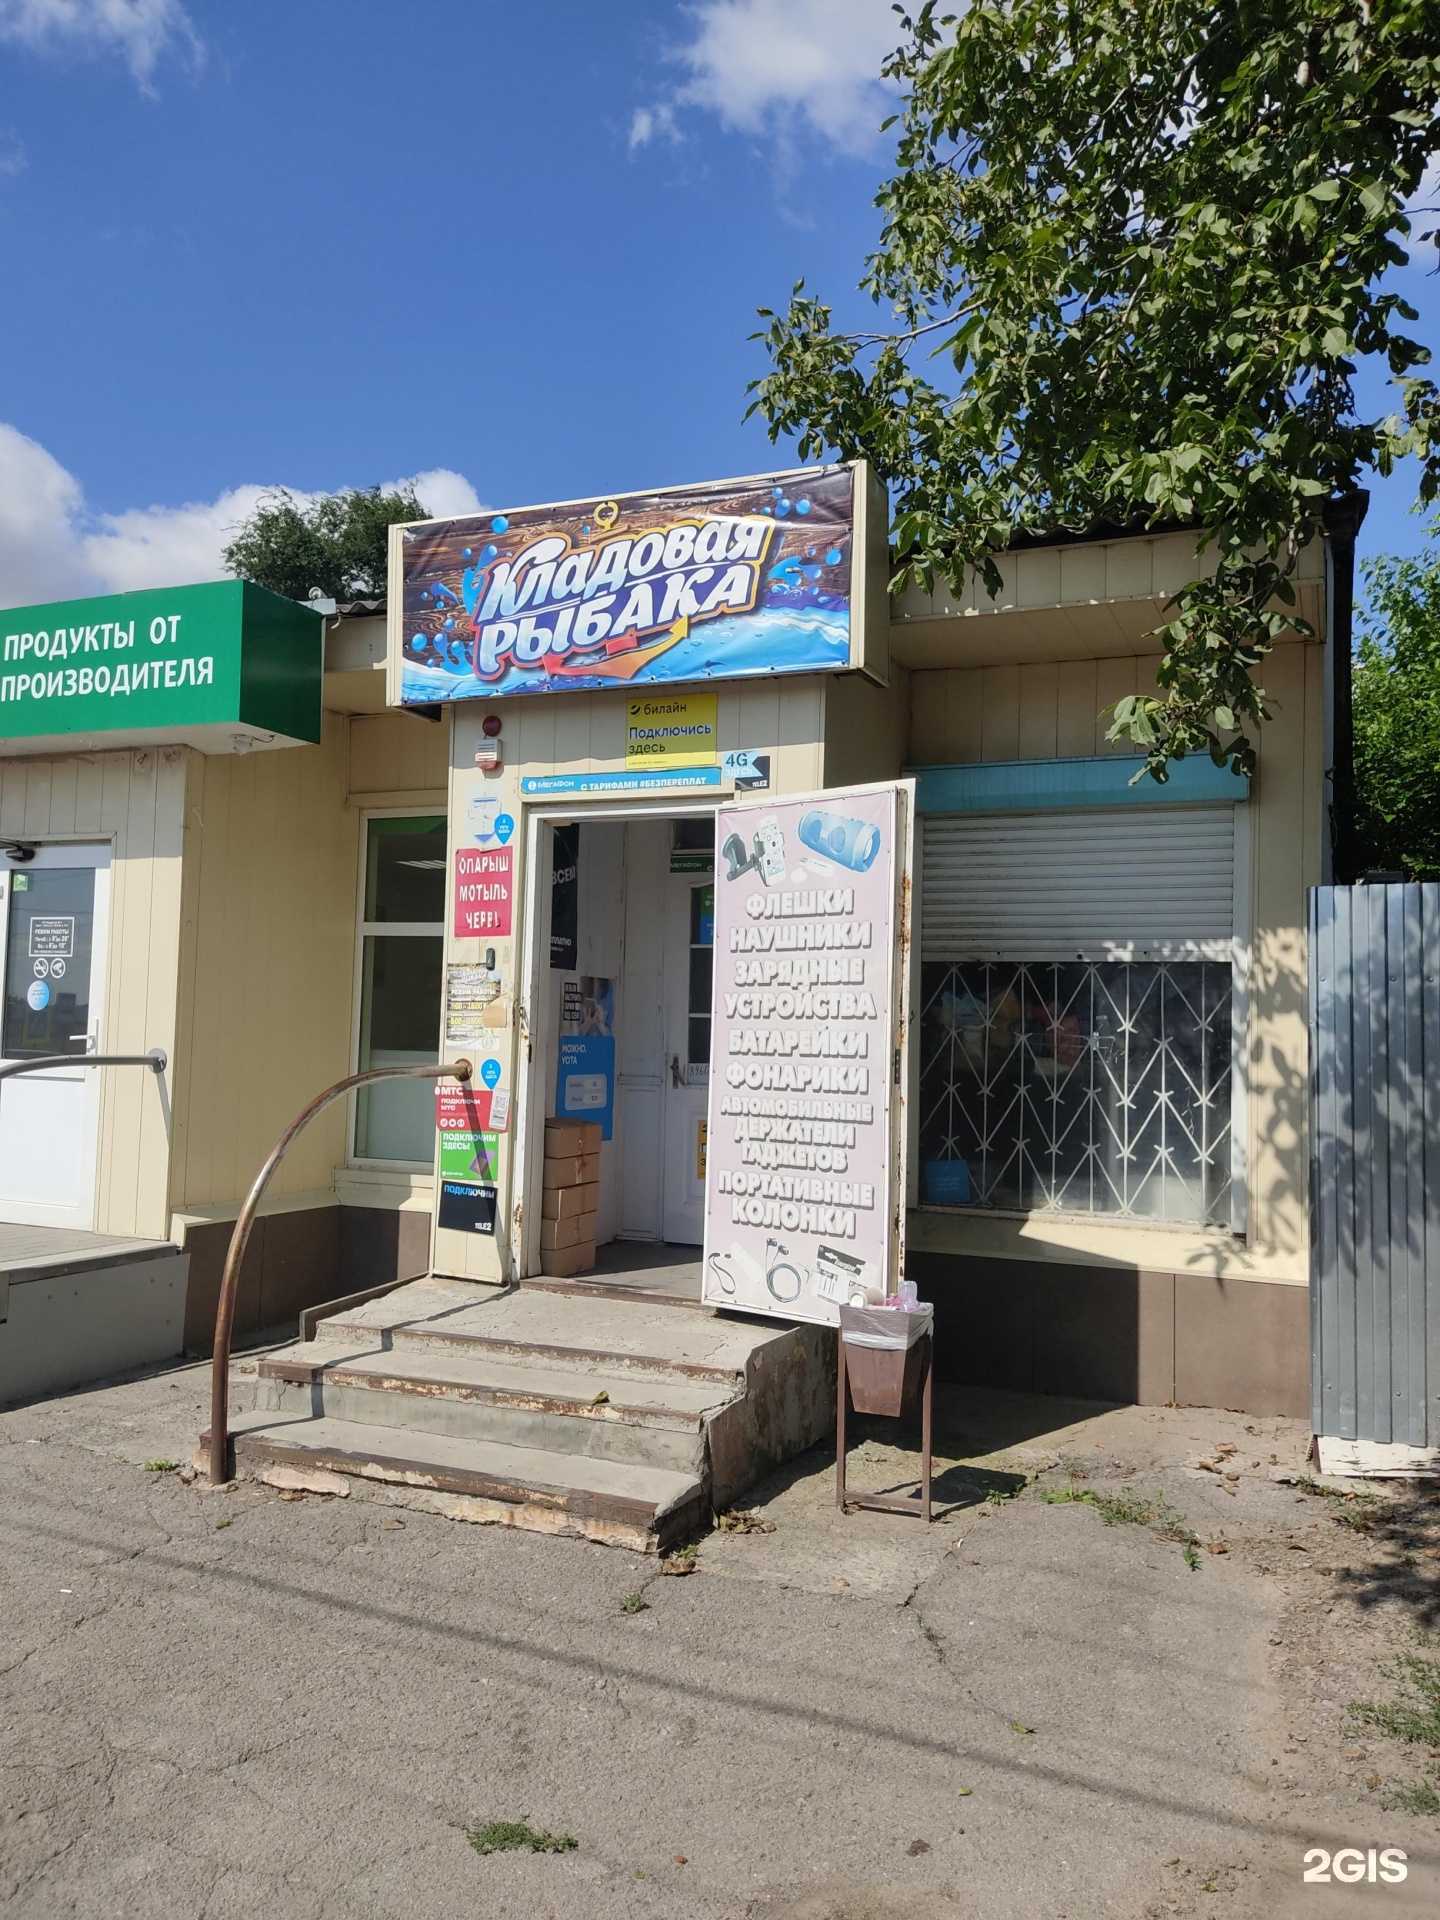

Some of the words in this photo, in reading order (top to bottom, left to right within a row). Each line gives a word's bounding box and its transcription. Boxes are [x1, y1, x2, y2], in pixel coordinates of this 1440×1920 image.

[477, 564, 752, 678] РЫБАКА
[4, 620, 135, 661] ПРОДУКТЫ
[150, 615, 182, 645] ОТ
[0, 656, 214, 702] ПРОИЗВОДИТЕЛЯ
[644, 703, 687, 715] билайн
[628, 742, 666, 755] здесь
[629, 724, 711, 742] Подключись
[725, 752, 748, 767] 4G
[588, 781, 638, 791] ТАРИФАМИ
[639, 777, 707, 789] #БЕЗПЕРЕПЛАТ
[459, 856, 509, 874] ОПАРЫШ
[459, 884, 508, 902] МОТЫЛЬ
[745, 888, 854, 919] ФЛЕШКИ
[730, 920, 872, 953] НАУШНИКИ
[734, 958, 865, 990] ЗАРЯДНЫЕ
[725, 990, 877, 1021] УСТРОЙСТВА
[729, 1026, 868, 1058] БАТАРЕЙКИ
[441, 1087, 463, 1096] МТС
[726, 1063, 868, 1095] ФОНАРИКИ
[720, 1096, 873, 1125] АВТОМОБИЛЬНЫЕ
[443, 1133, 496, 1142] ПОДКЛЮЧИМ
[734, 1118, 856, 1149] ДЕРЖАТЕЛИ
[741, 1141, 848, 1173] ГАДЖЕТОВ
[444, 1184, 495, 1199] ПОДКЛЮЧИМ
[718, 1171, 875, 1209] ПОРТАТИВНЫЕ
[732, 1199, 856, 1239] КОЛОНКИ
